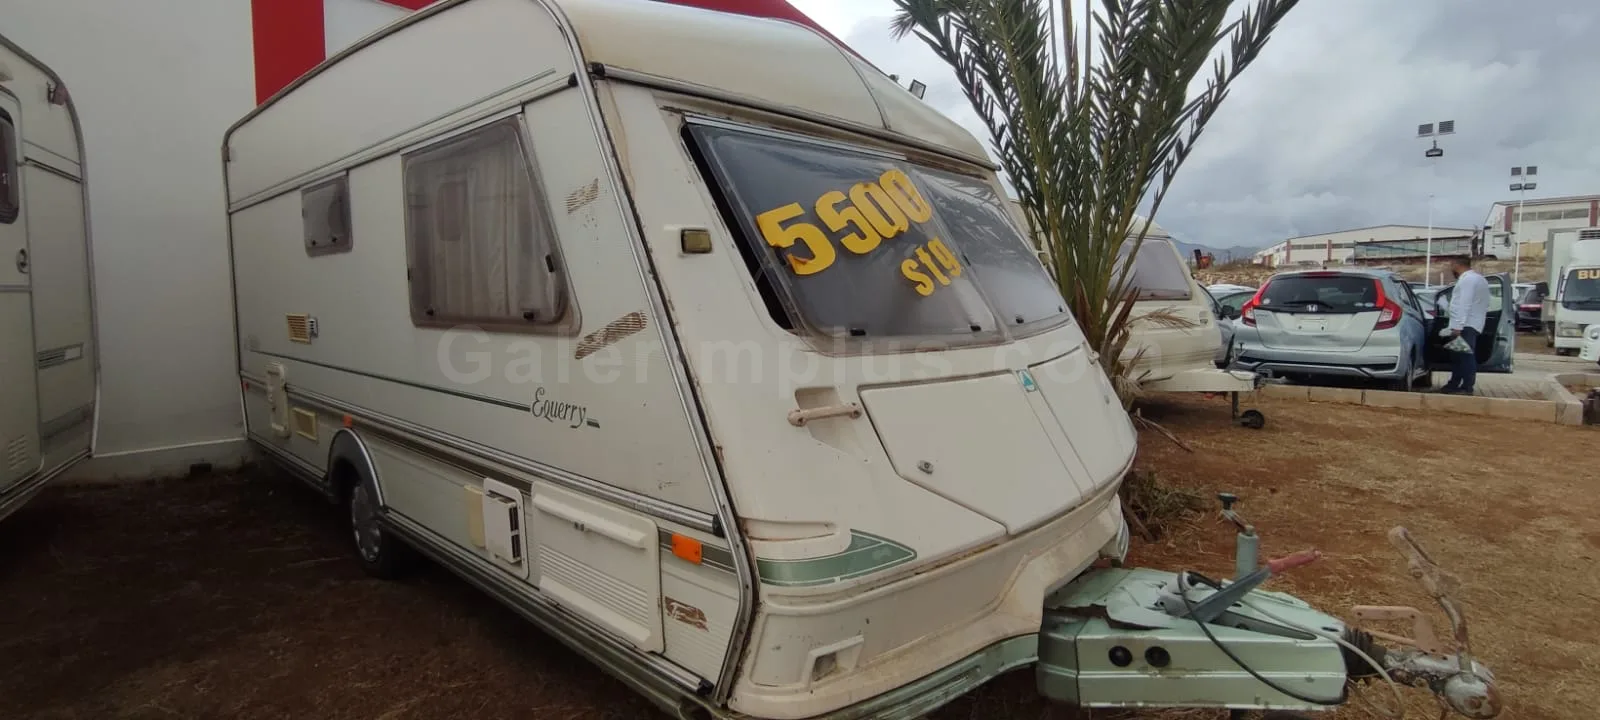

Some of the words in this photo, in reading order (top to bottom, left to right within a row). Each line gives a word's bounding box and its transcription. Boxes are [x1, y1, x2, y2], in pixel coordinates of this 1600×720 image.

[756, 169, 932, 275] 5500
[901, 236, 961, 296] stg
[532, 387, 586, 428] Equerry
